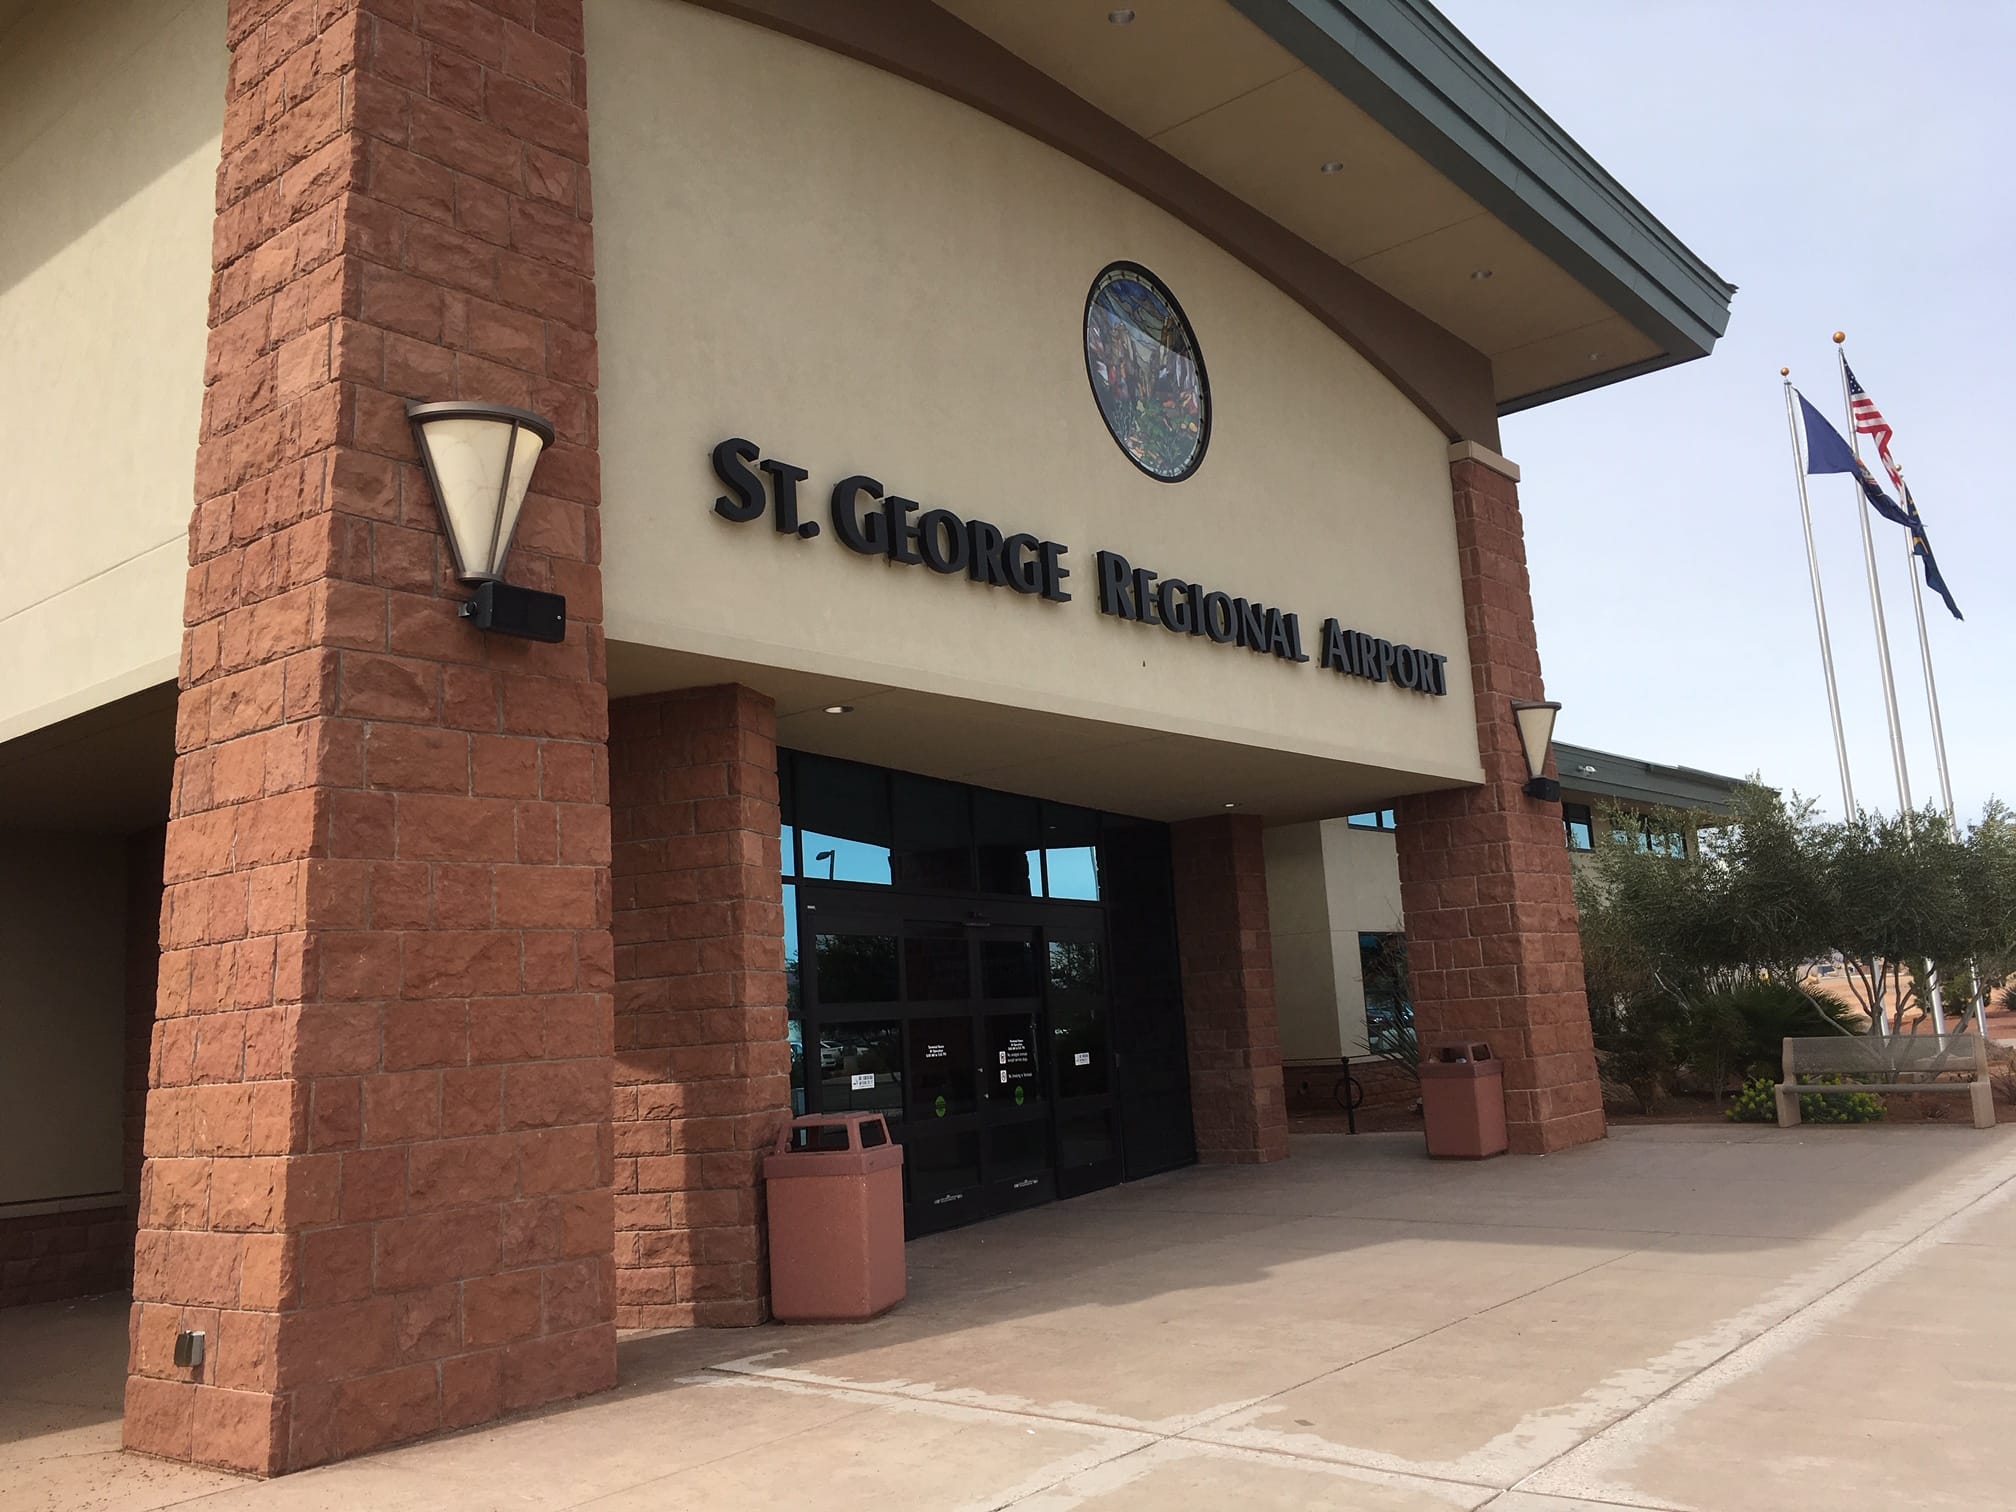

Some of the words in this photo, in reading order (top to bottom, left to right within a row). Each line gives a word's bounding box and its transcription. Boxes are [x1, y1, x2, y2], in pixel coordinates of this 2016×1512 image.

[713, 437, 820, 539] ST.
[831, 475, 1071, 602] GEORGE
[1096, 550, 1309, 661] REGIONAL
[1321, 618, 1447, 695] AIRPORT
